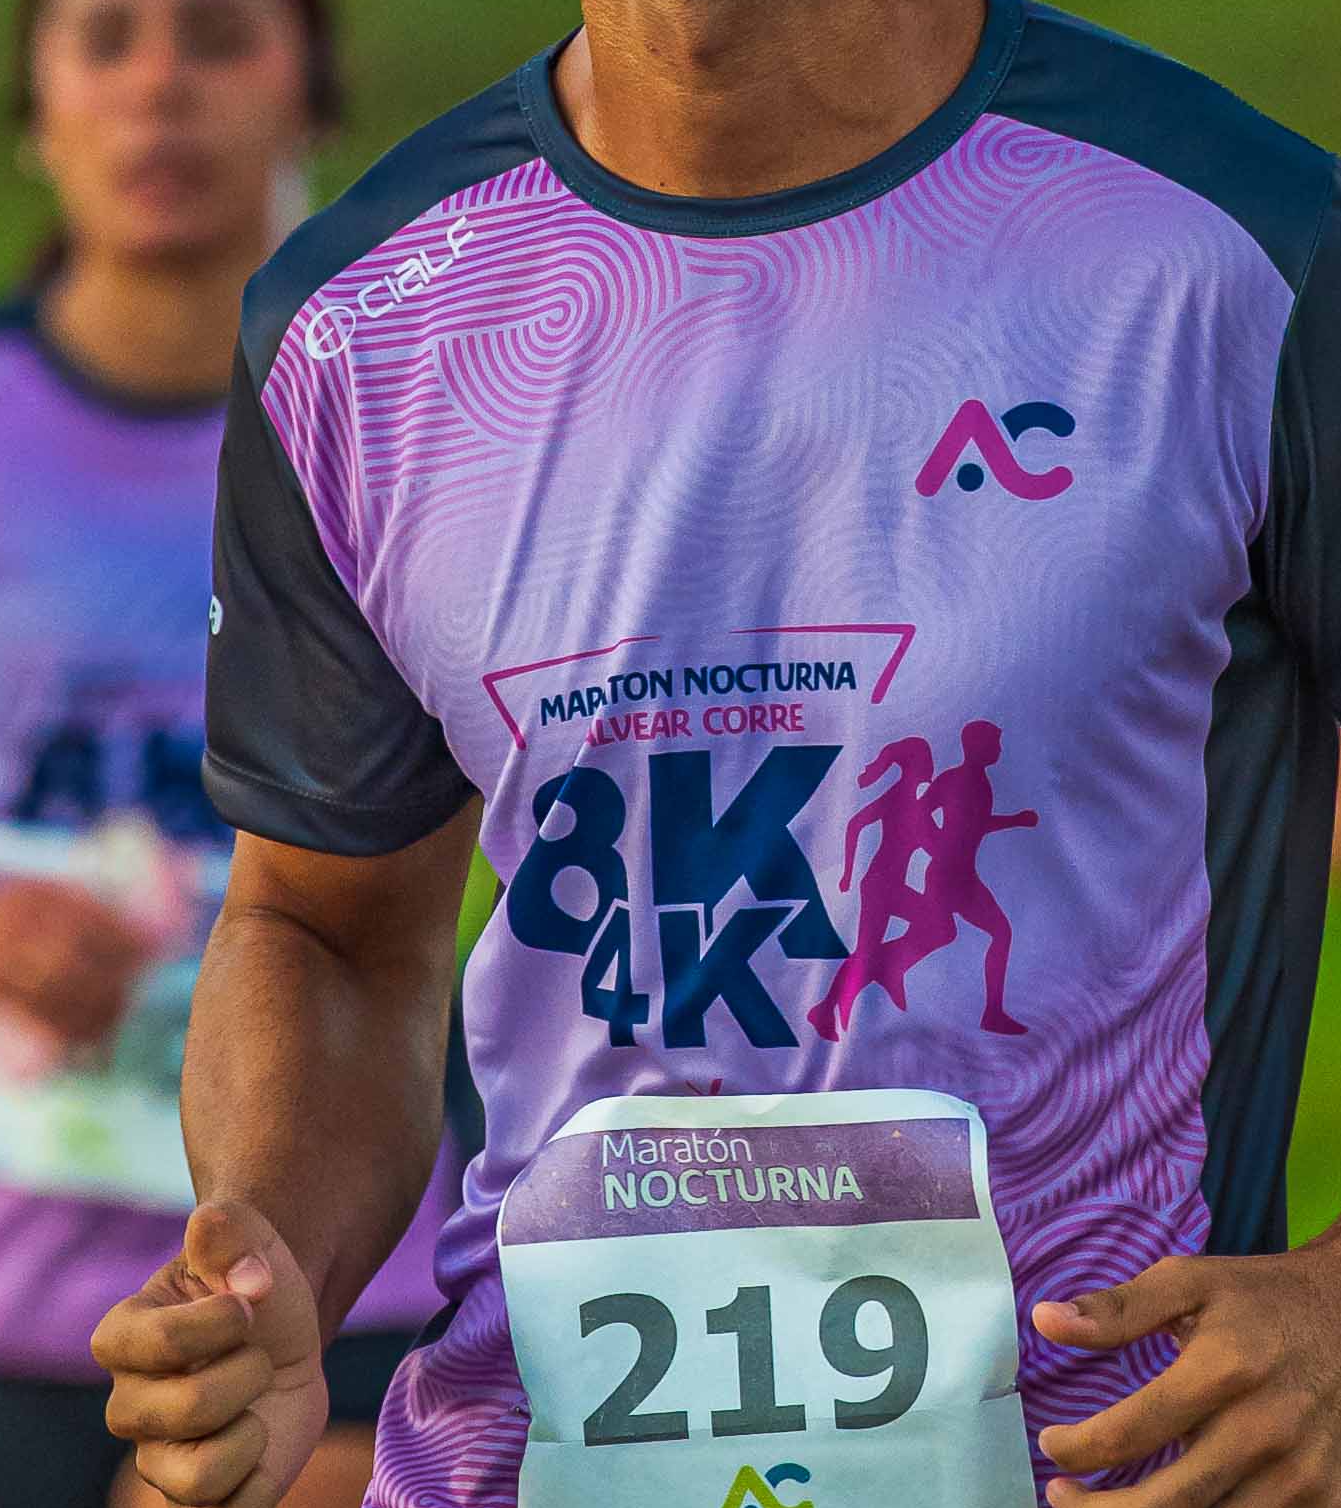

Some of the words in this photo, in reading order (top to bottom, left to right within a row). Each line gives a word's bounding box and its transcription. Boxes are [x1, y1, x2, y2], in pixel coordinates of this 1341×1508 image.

[540, 668, 673, 726] MARTON
[683, 661, 857, 696] NOCTURNA
[702, 703, 805, 735] CORRE
[507, 745, 853, 959] 8K
[581, 905, 801, 1050] 4K
[602, 1128, 753, 1168] Maratón
[603, 1165, 865, 1211] NOCTURNA
[578, 1274, 929, 1447] 219
